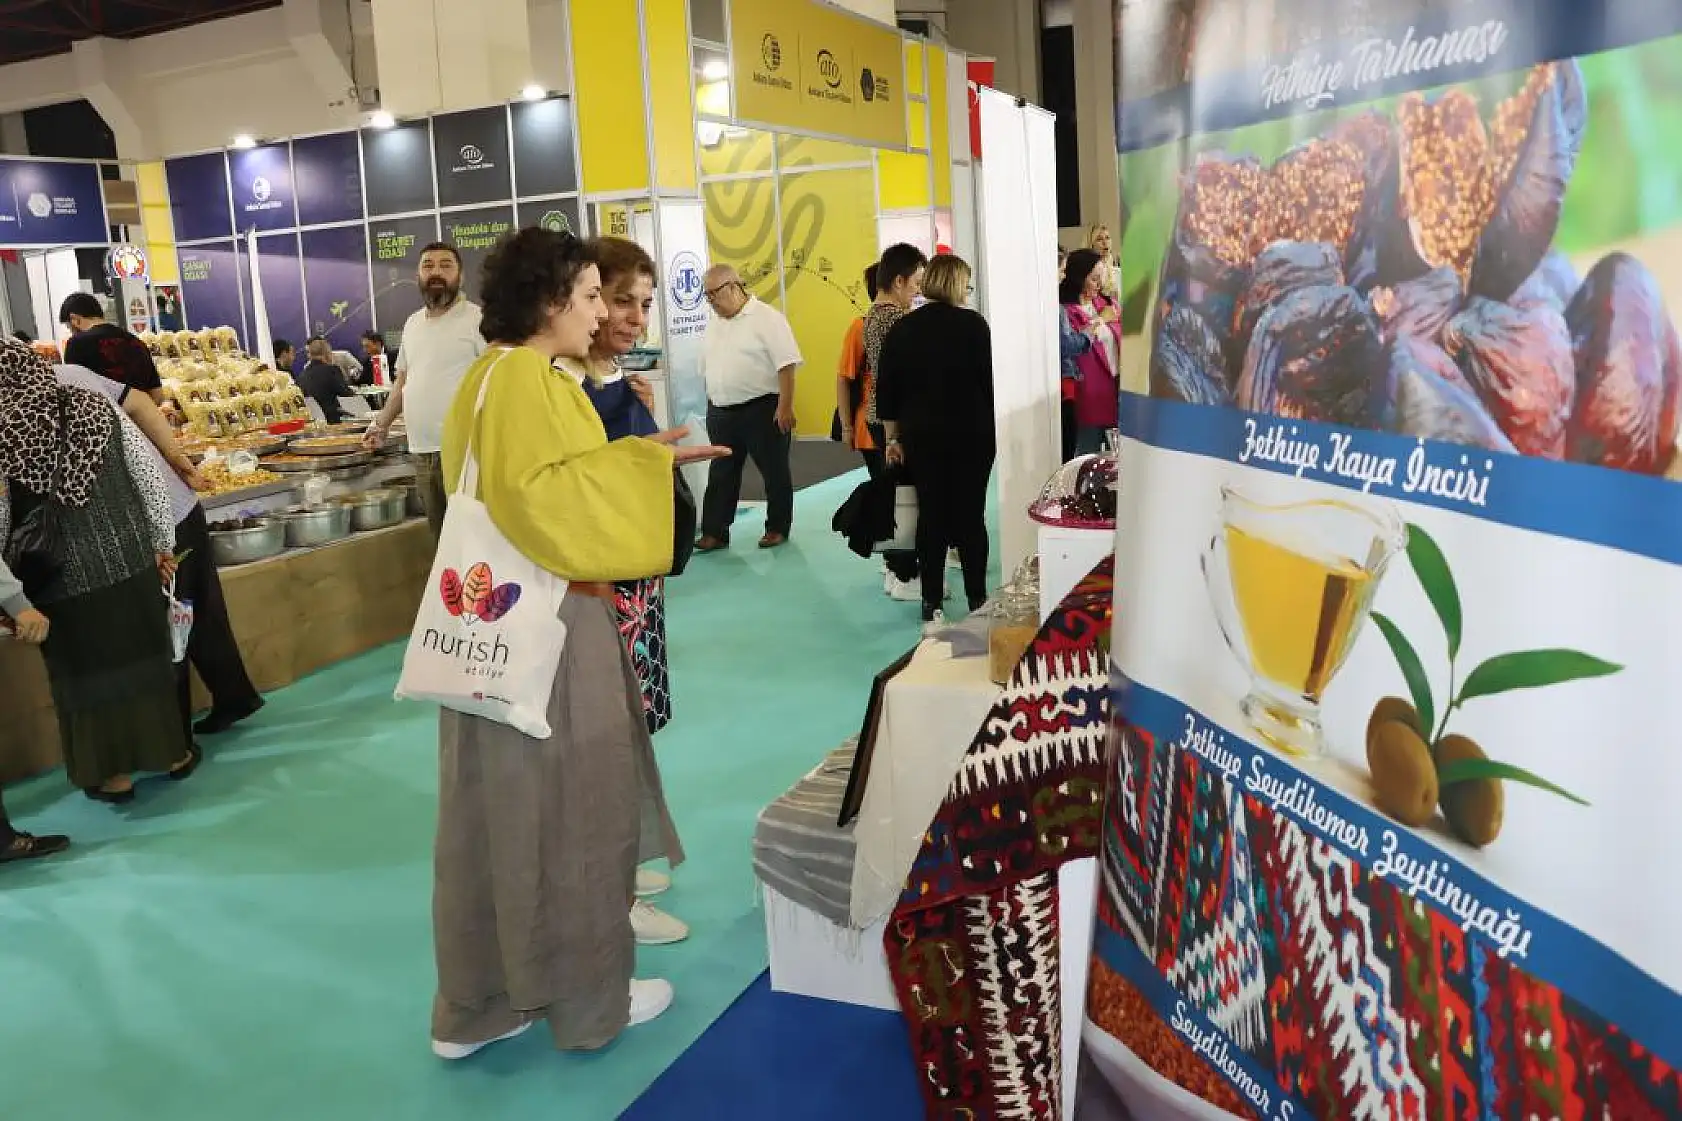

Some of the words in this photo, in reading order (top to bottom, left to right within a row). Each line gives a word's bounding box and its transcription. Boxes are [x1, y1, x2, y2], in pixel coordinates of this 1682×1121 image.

[1262, 52, 1343, 109] Fethiye
[1351, 20, 1507, 90] Tarhanası
[1239, 418, 1320, 480] Fethiye
[1324, 432, 1397, 494] Kaya
[1402, 436, 1493, 507] İnciri
[423, 628, 509, 665] nurish
[1180, 713, 1242, 780] Fethiye
[1245, 755, 1369, 856] Seydikemer
[1372, 830, 1533, 958] Zeytinyağı
[1170, 999, 1270, 1115] Seydikemer
